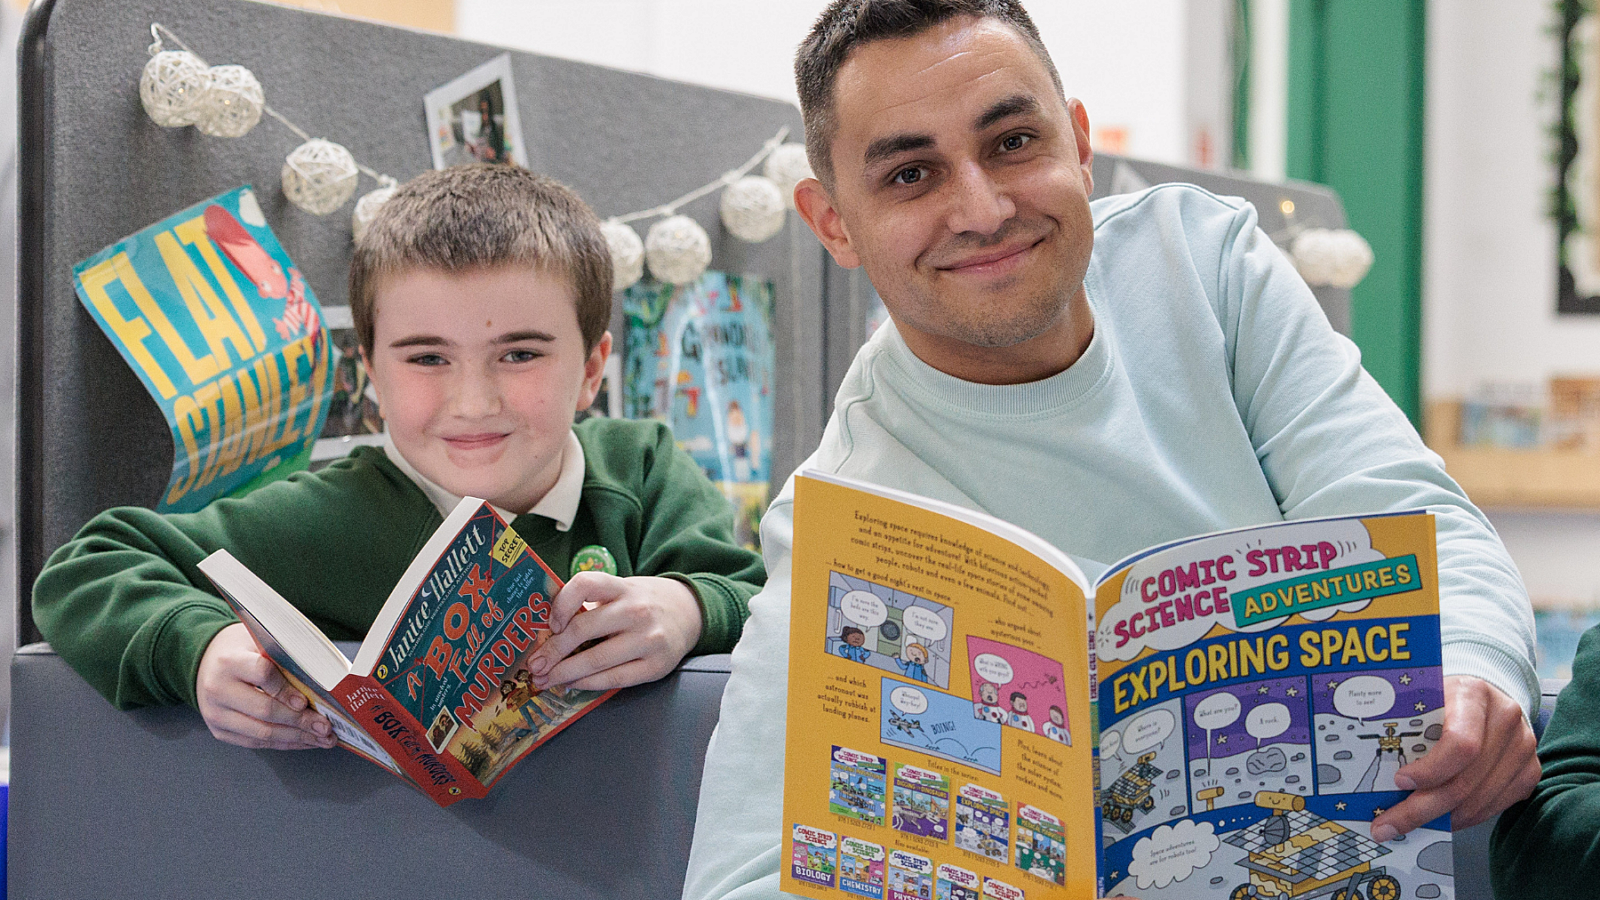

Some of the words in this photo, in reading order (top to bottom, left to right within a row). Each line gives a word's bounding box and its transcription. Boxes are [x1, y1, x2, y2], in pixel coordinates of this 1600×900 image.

[79, 213, 266, 400] FLAT
[166, 327, 328, 505] STANLEY
[499, 538, 510, 553] TOP
[501, 534, 522, 563] SECRET
[855, 510, 887, 529] Exploring
[890, 523, 908, 532] space
[910, 529, 938, 541] requires
[940, 534, 973, 554] knowledge
[975, 548, 982, 556] of
[984, 553, 1006, 566] science
[1007, 563, 1019, 572] and
[859, 526, 872, 535] and
[884, 534, 911, 545] appetite
[913, 539, 923, 549] for
[979, 561, 1008, 579] hilarious
[455, 560, 474, 584] AUTHOR
[850, 537, 870, 547] comic
[895, 550, 923, 561] uncover
[925, 555, 936, 565] the
[968, 571, 984, 581] space
[986, 578, 1007, 591] stories
[1016, 592, 1031, 602] some
[876, 556, 900, 568] people,
[902, 562, 924, 574] robots
[926, 570, 939, 578] and
[940, 575, 956, 584] even
[963, 579, 974, 590] few
[1140, 555, 1237, 604] COMIC
[1246, 541, 1338, 578] STRIP
[833, 558, 846, 569] how
[847, 563, 854, 571] to
[855, 567, 866, 576] get
[872, 573, 888, 582] good
[889, 577, 911, 589] night's
[912, 584, 925, 593] rest
[934, 591, 951, 601] space
[388, 601, 431, 673] Janice
[429, 524, 486, 602] Hallett
[1243, 563, 1413, 619] ADVENTURES
[1114, 586, 1230, 649] SCIENCE
[407, 670, 422, 701] A
[423, 563, 495, 681] BOX
[448, 623, 485, 683] Full
[481, 597, 504, 628] of
[454, 592, 552, 733] MURDERS
[1113, 635, 1290, 715] EXPLORING
[1299, 623, 1411, 669] SPACE
[835, 675, 847, 683] and
[849, 677, 867, 688] which
[346, 685, 379, 703] Janice
[825, 684, 856, 697] astronaut
[857, 692, 869, 700] was
[1348, 690, 1367, 698] Plenty
[349, 692, 386, 712] Hallett
[817, 693, 843, 707] actually
[844, 700, 868, 713] rubbish
[869, 706, 876, 714] at
[1199, 710, 1212, 718] What
[1224, 703, 1238, 715] you?
[822, 703, 847, 719] landing
[847, 711, 870, 723] planes.
[930, 720, 957, 735] BOING!
[373, 711, 410, 739] BOX
[414, 753, 457, 786] MURDERS
[927, 759, 943, 771] Titles
[950, 767, 960, 776] the
[1016, 762, 1026, 772] the
[1028, 768, 1042, 778] solar
[1021, 753, 1031, 763] the
[1032, 759, 1052, 772] science
[1048, 755, 1063, 768] about
[1015, 775, 1037, 788] rockets
[1038, 782, 1048, 792] and
[961, 797, 989, 812] EXPLORING
[797, 827, 816, 837] COMIC
[817, 832, 833, 841] STRIP
[805, 835, 827, 846] SCIENCE
[845, 839, 863, 849] COMIC
[864, 844, 880, 853] STRIP
[895, 839, 906, 847] Also
[1150, 849, 1165, 858] Space
[1165, 840, 1195, 852] adventures
[852, 847, 875, 858] SCIENCE
[893, 852, 912, 862] COMIC
[913, 857, 929, 866] STRIP
[1168, 851, 1185, 859] robots
[796, 866, 831, 882] BIOLOGY
[900, 860, 923, 871] SCIENCE
[941, 865, 959, 875] COMIC
[841, 879, 882, 895] CHEMISTRY
[948, 873, 970, 885] SCIENCE
[988, 881, 1005, 891] COMIC
